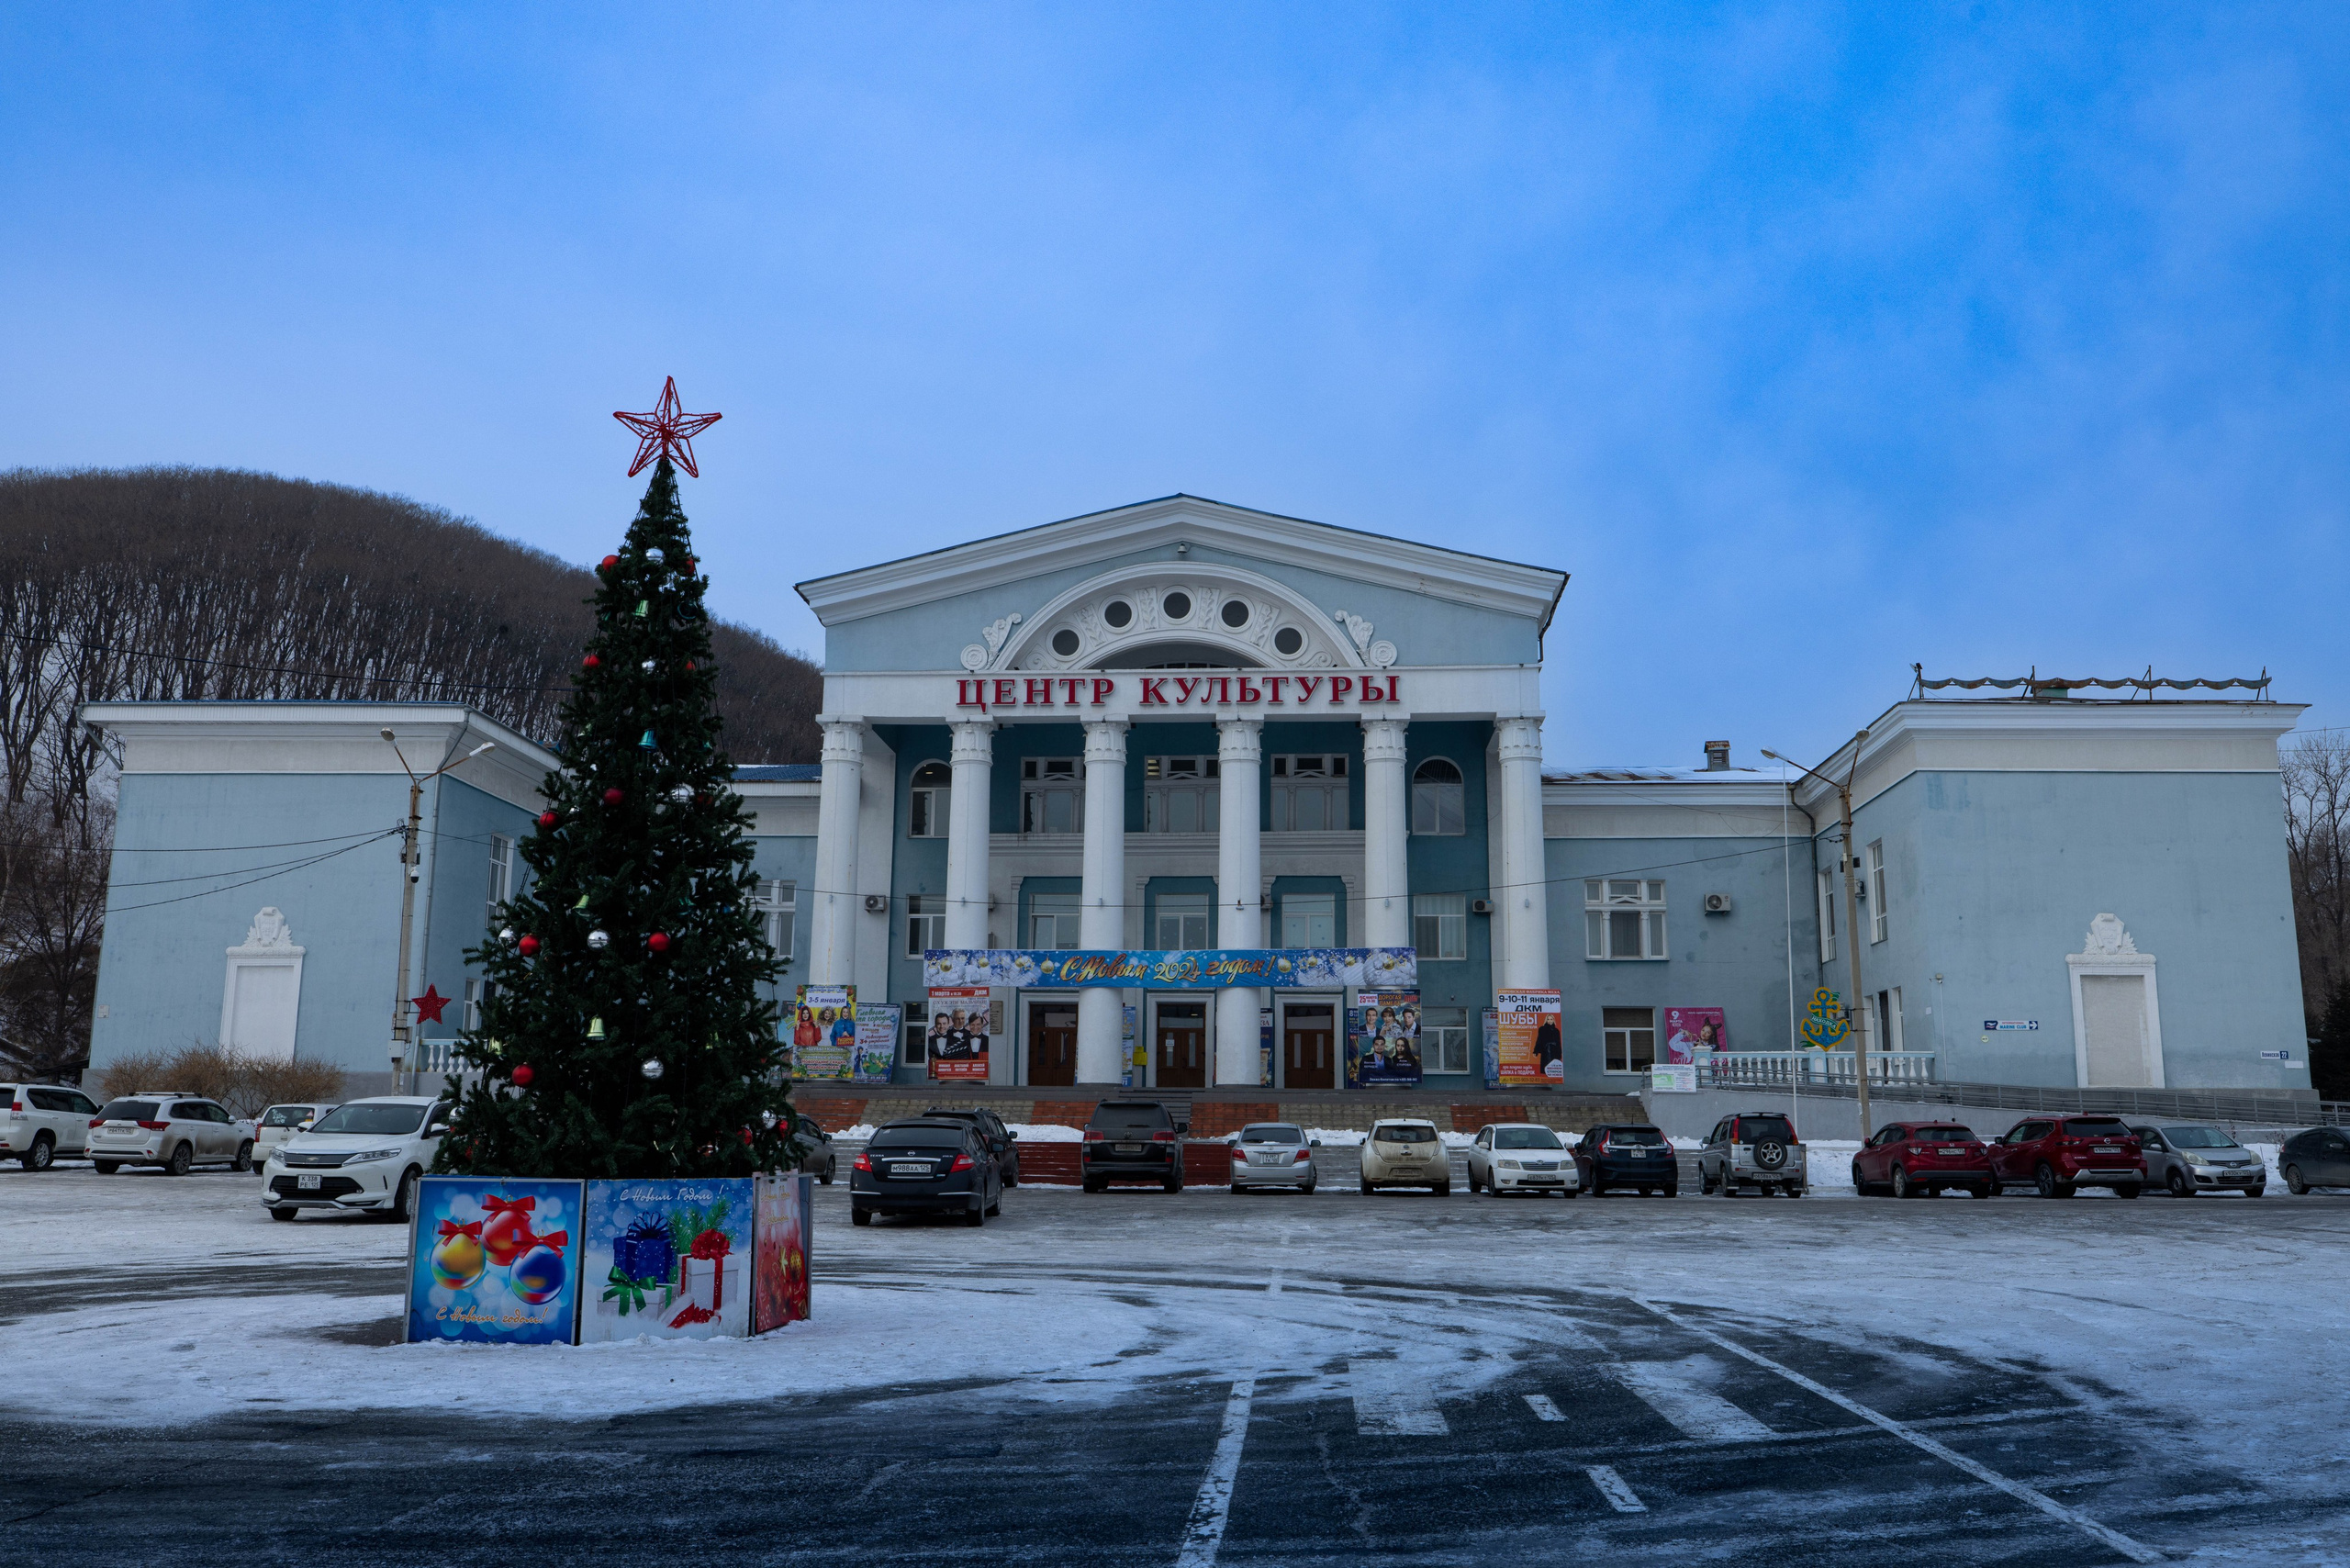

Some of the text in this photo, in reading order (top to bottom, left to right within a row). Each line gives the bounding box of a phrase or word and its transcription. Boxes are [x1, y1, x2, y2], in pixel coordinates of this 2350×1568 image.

[956, 675, 1400, 714] ЦЕНТР КУЛЬТУРЫ
[1076, 953, 1148, 983] Новым
[1153, 957, 1201, 983] 2024
[1204, 956, 1276, 985] годом!
[1499, 1013, 1537, 1025] ШУБЫ
[1671, 1011, 1679, 1020] 9
[1811, 1015, 1837, 1028] НАХОДКА
[620, 1189, 629, 1201] С
[632, 1187, 673, 1202] Новым
[677, 1187, 713, 1202] Годом
[436, 1305, 549, 1325] С Новым годом!
